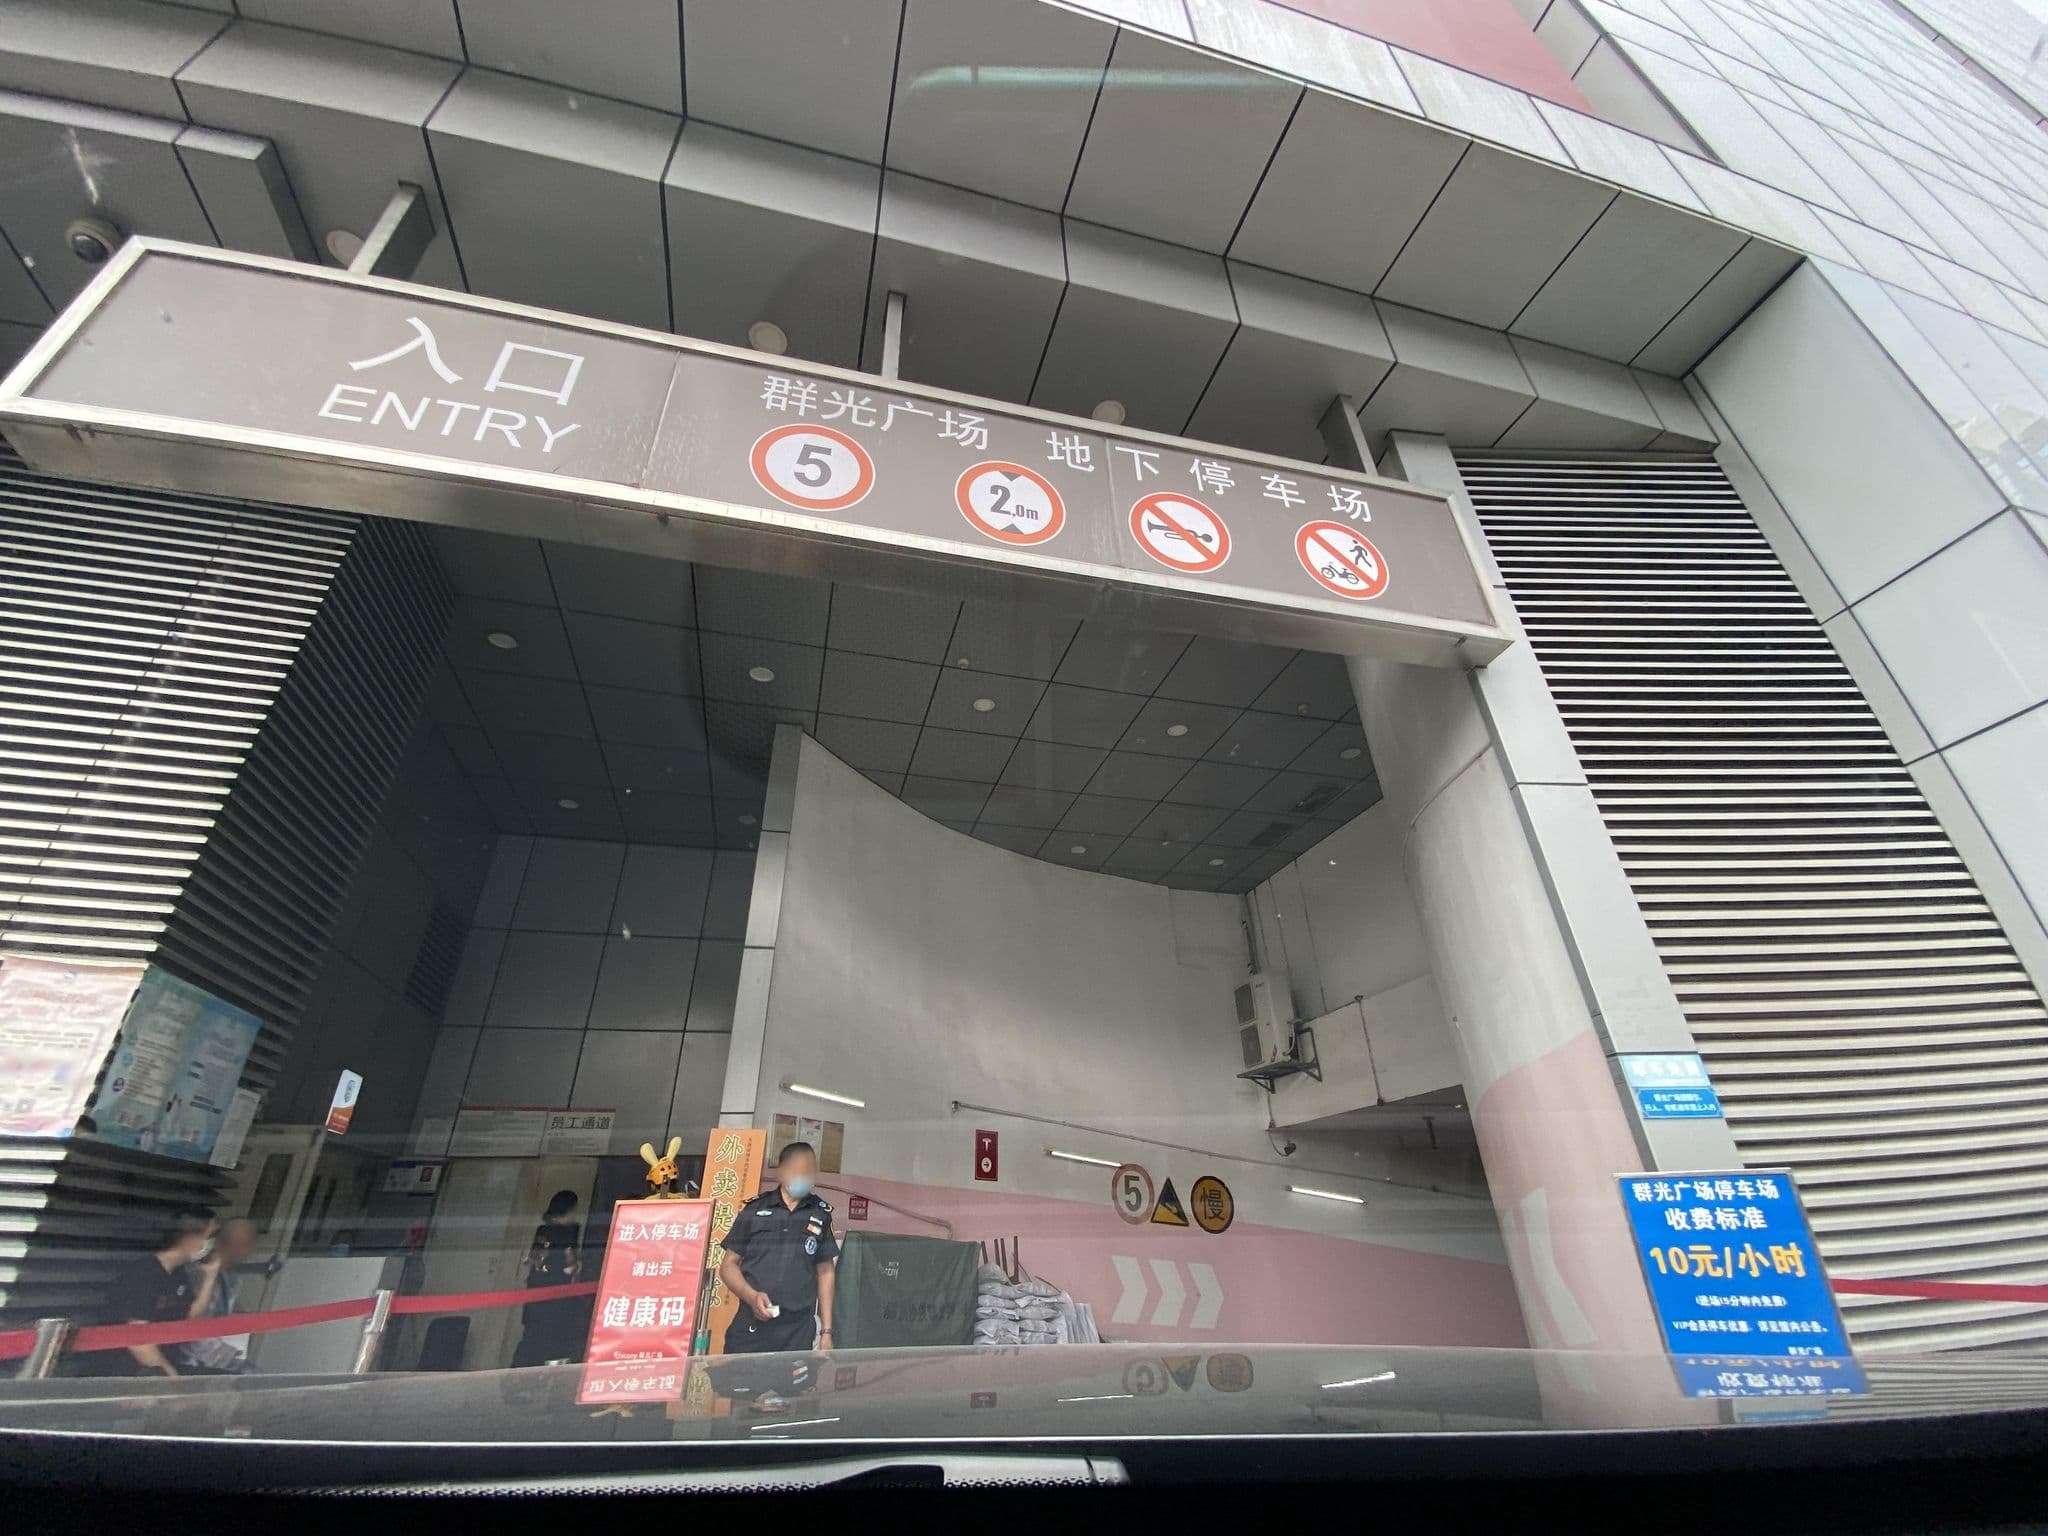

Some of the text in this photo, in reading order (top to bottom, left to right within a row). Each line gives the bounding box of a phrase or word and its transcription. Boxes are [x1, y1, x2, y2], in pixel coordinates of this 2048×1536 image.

[349, 316, 585, 406] 入口
[318, 382, 582, 454] ENTRY
[760, 375, 1373, 523] 群光广场 地下停车场
[793, 443, 833, 488] 5
[550, 1116, 612, 1130] 员工通道
[1123, 1174, 1142, 1212] 5
[1200, 1187, 1225, 1221] 慢
[1631, 1179, 1780, 1202] 群光广场停车场
[618, 1222, 700, 1241] 进入停车场
[1664, 1206, 1769, 1231] 收费标准
[631, 1261, 673, 1277] 请出示
[1650, 1242, 1807, 1279] 10元/小时
[602, 1295, 687, 1329] 健康码
